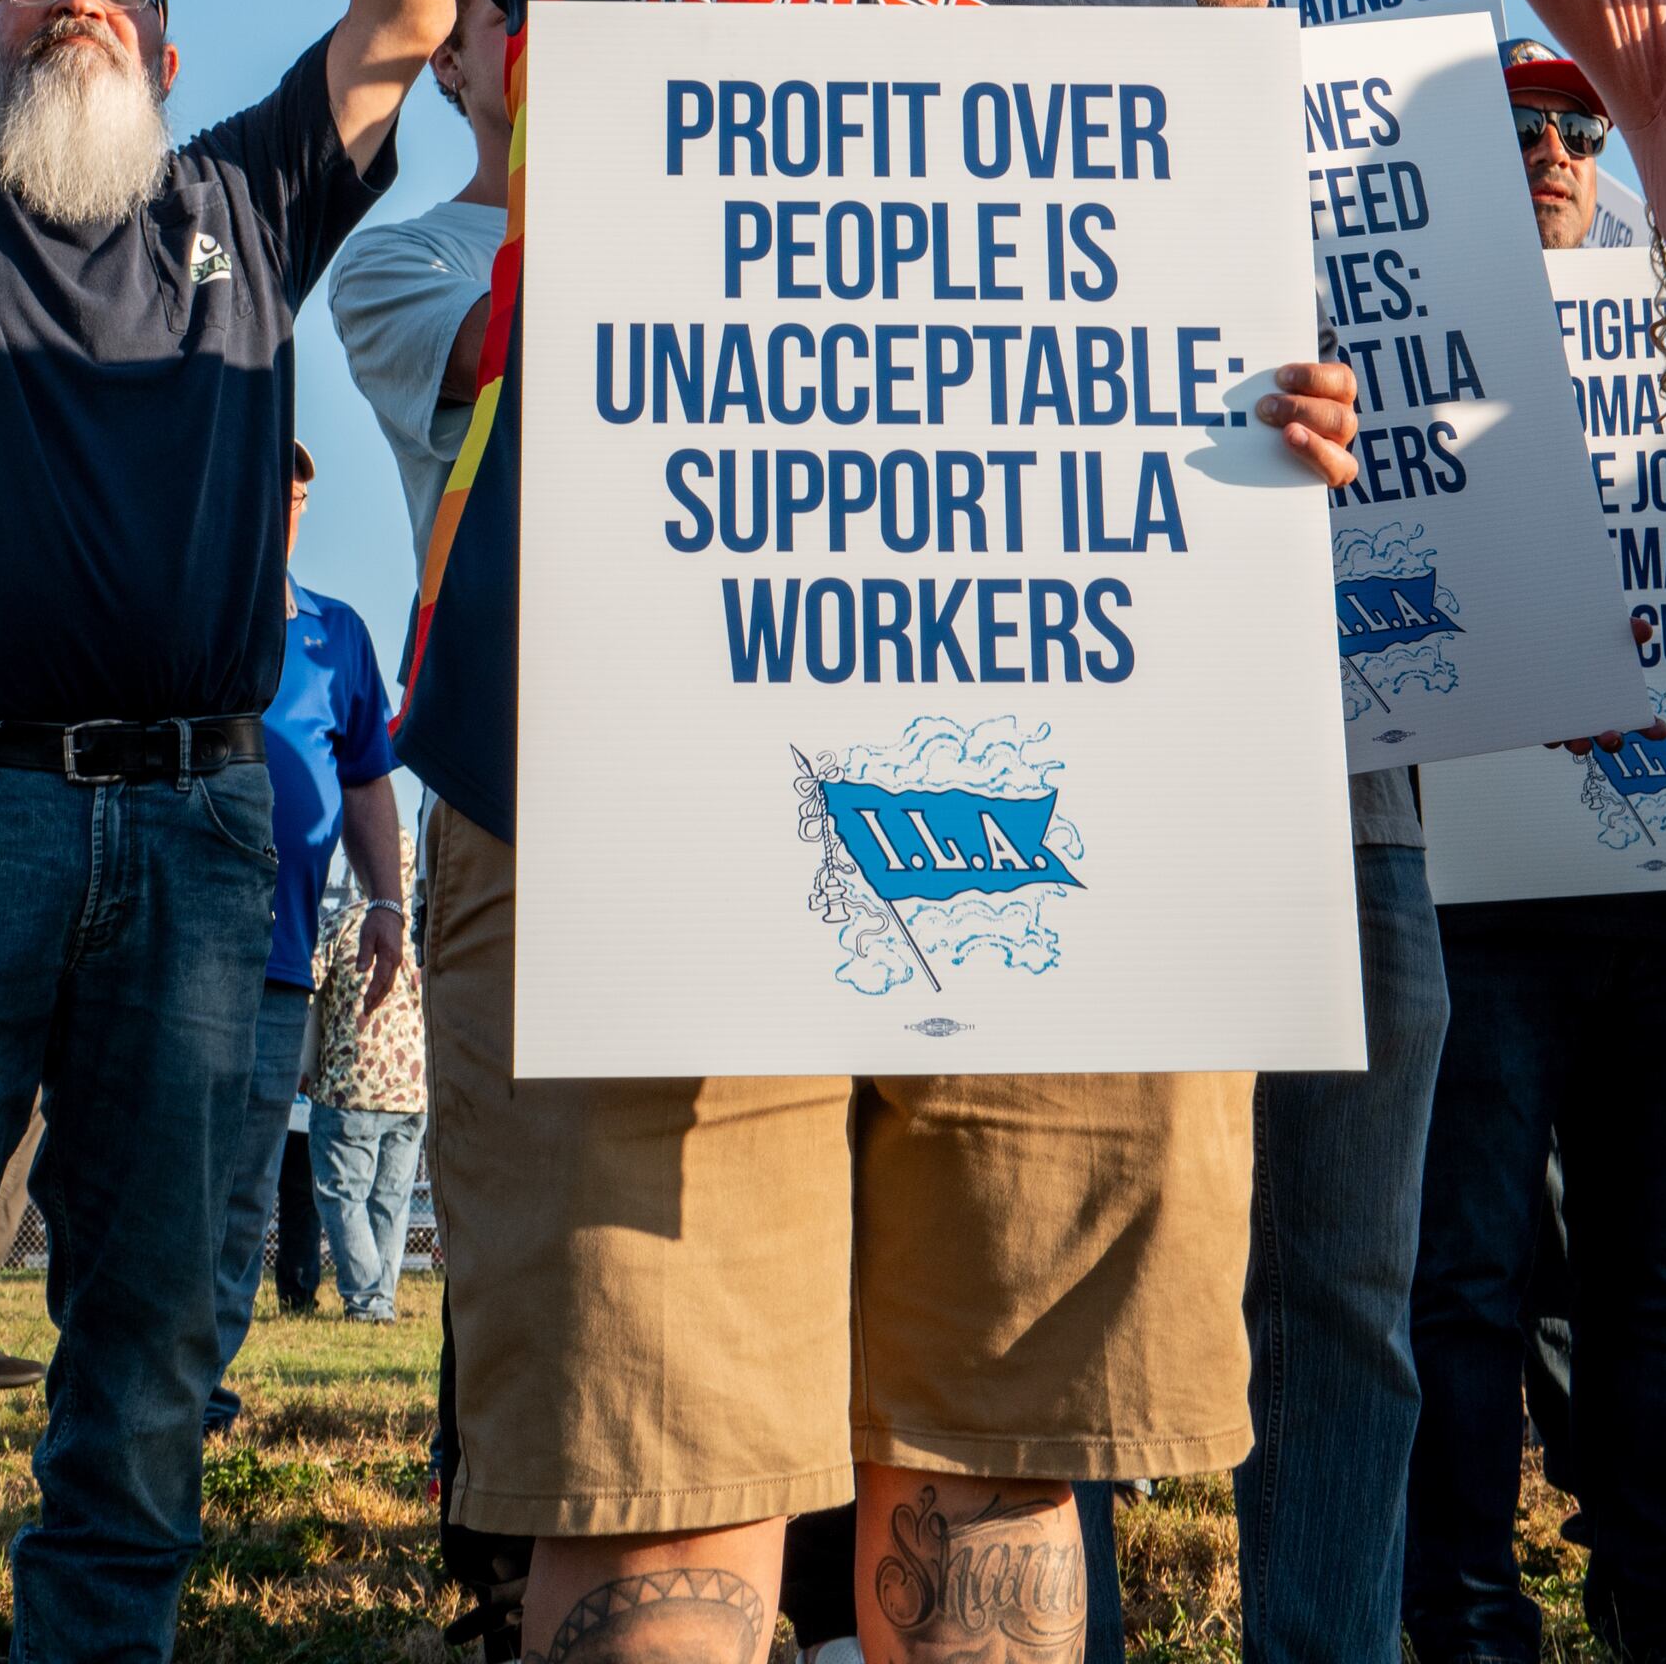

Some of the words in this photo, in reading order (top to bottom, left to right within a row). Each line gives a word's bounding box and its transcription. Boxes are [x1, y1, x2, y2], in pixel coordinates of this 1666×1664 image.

[666, 79, 942, 179] PROFIT
[962, 82, 1171, 180] OVER
[724, 199, 1023, 300] PEOPLE
[1048, 202, 1118, 301] IS
[1309, 160, 1429, 240] FEED
[1325, 249, 1428, 327] IES:
[596, 322, 1247, 428] UNACCEPTABLE:
[1394, 330, 1485, 407] ILA
[665, 448, 1035, 553] SUPPORT
[1062, 451, 1188, 553] ILA
[723, 576, 1134, 683] WORKERS
[861, 807, 1049, 876] I.L.A.
